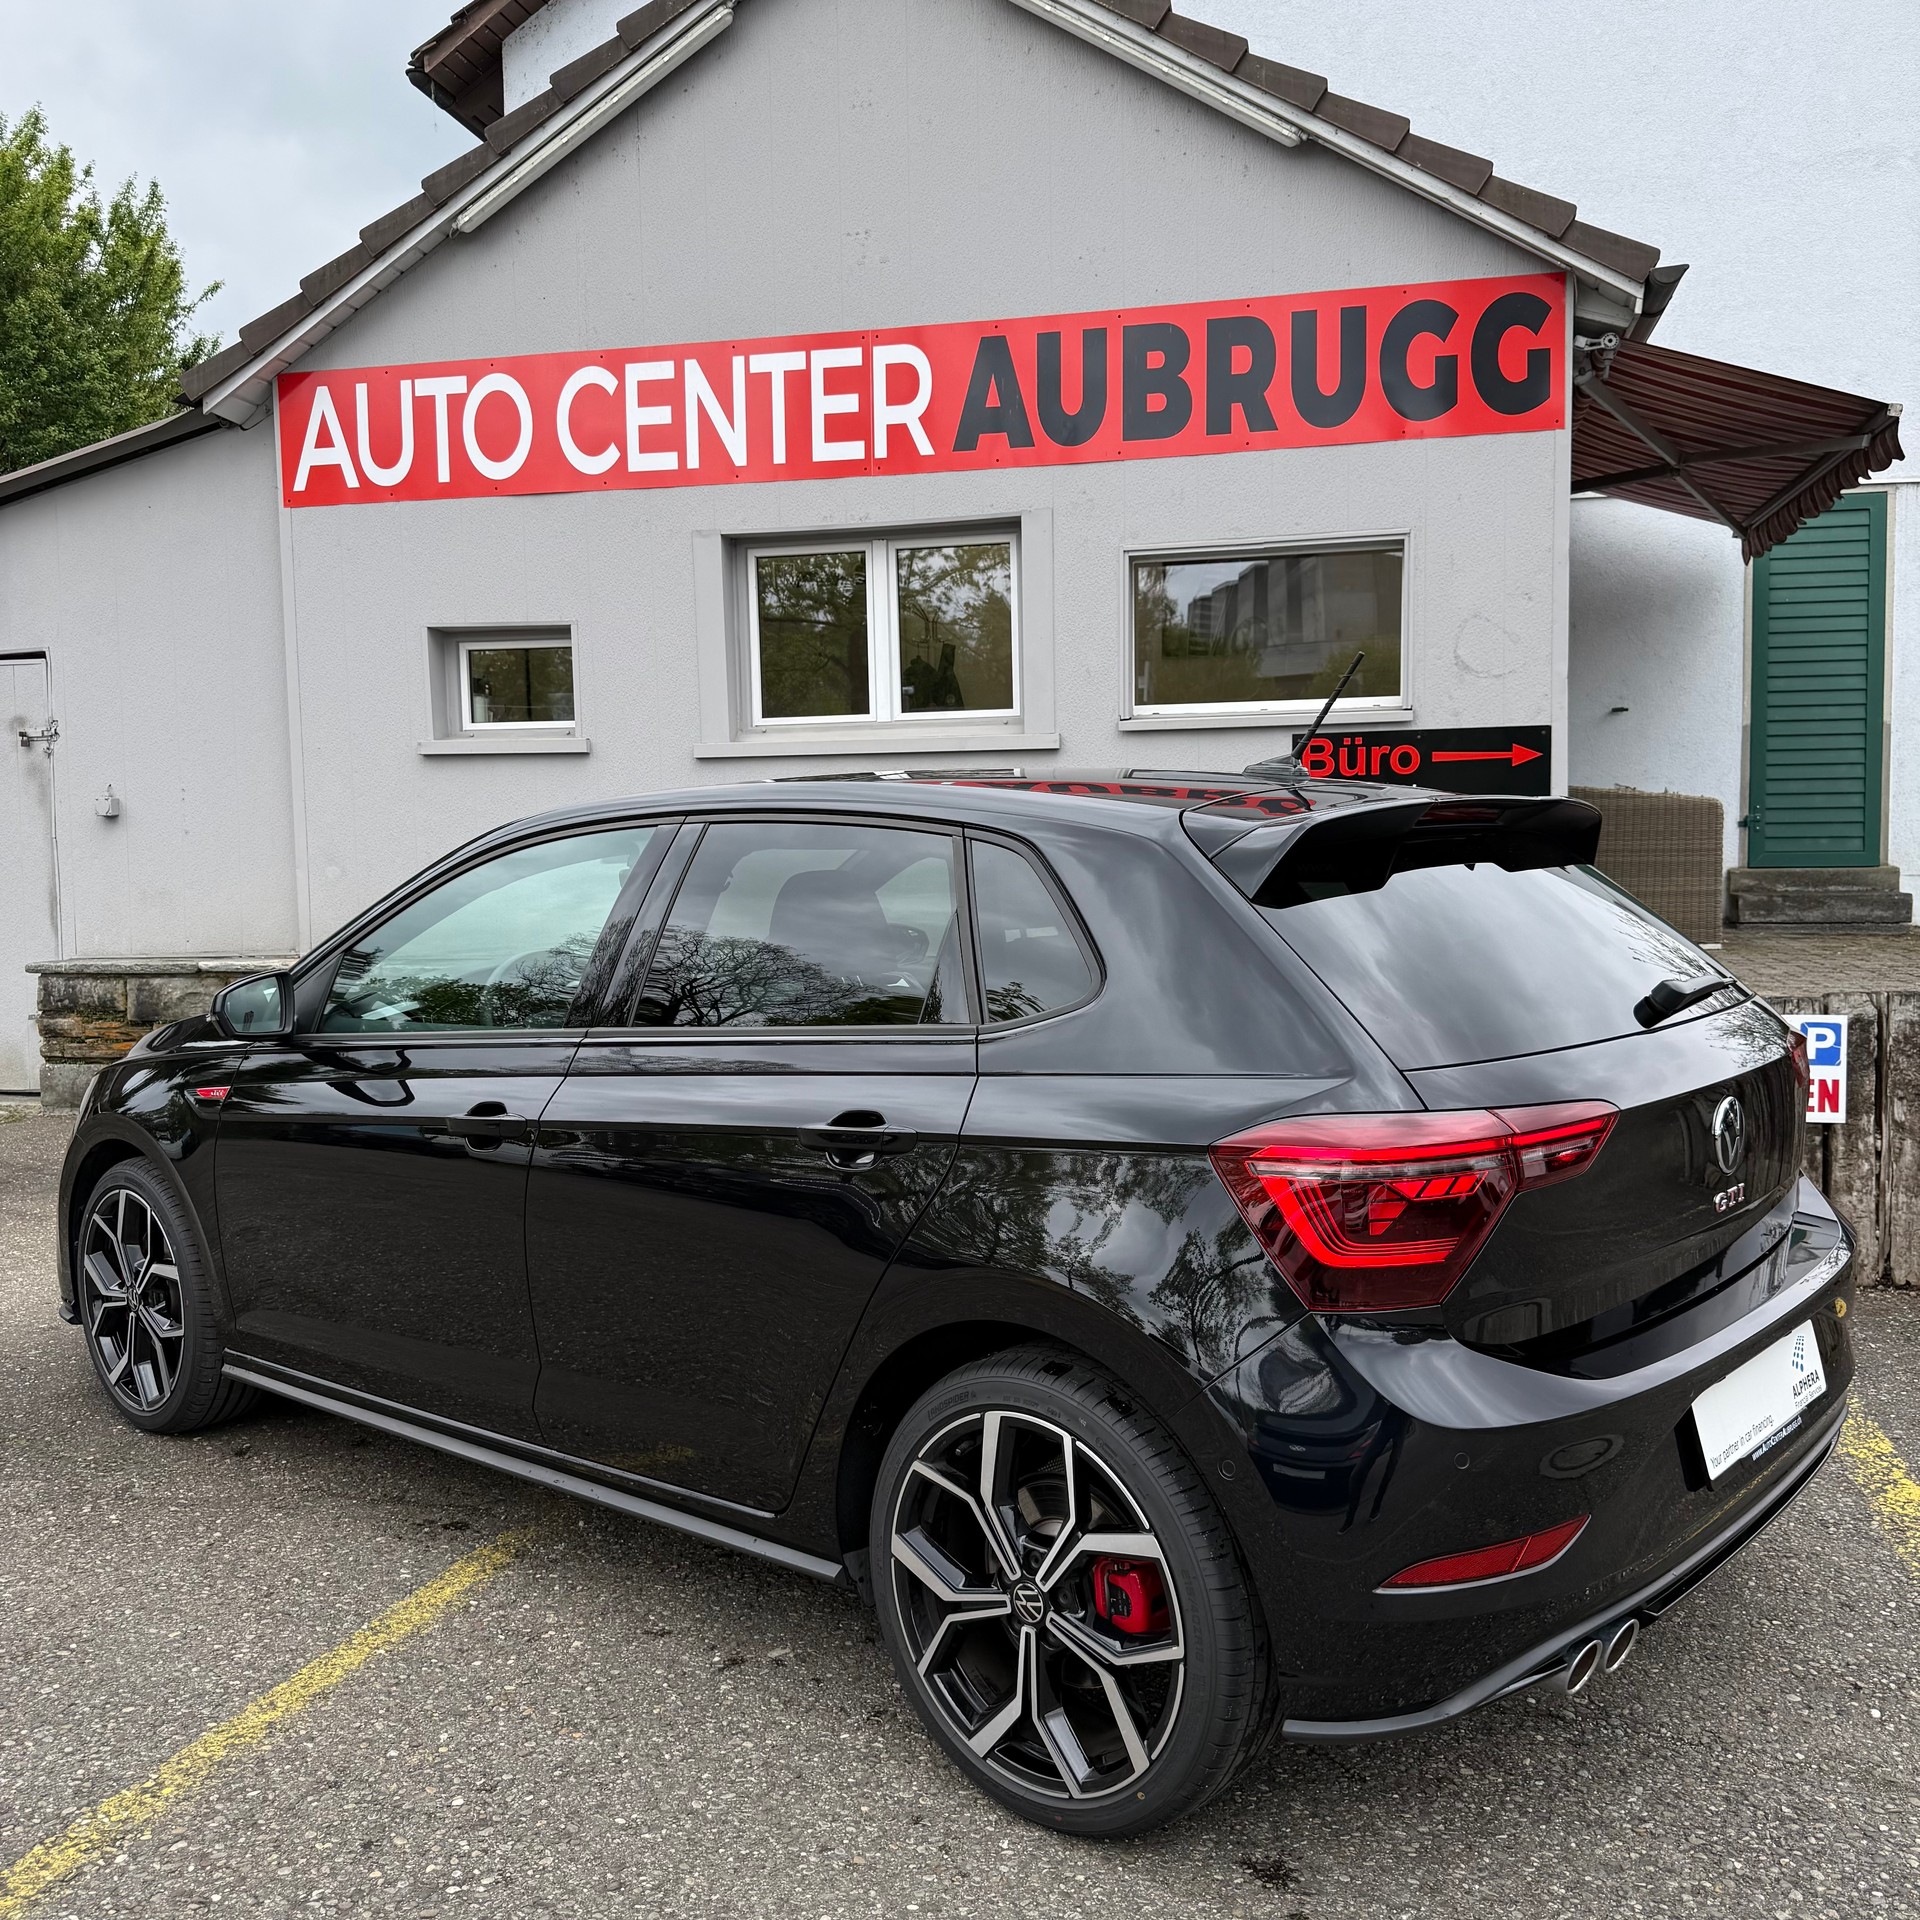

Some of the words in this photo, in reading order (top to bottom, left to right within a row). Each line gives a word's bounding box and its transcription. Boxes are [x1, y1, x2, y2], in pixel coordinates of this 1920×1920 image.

[293, 372, 534, 491] AUTO
[556, 343, 935, 475] CENTER
[952, 292, 1553, 452] AUBRUGG
[1302, 737, 1421, 777] Büro
[1713, 1182, 1745, 1213] GTI
[1792, 1369, 1820, 1400] ALPHERA
[1710, 1451, 1723, 1469] Your
[1722, 1438, 1740, 1463] partner
[1745, 1430, 1753, 1443] car
